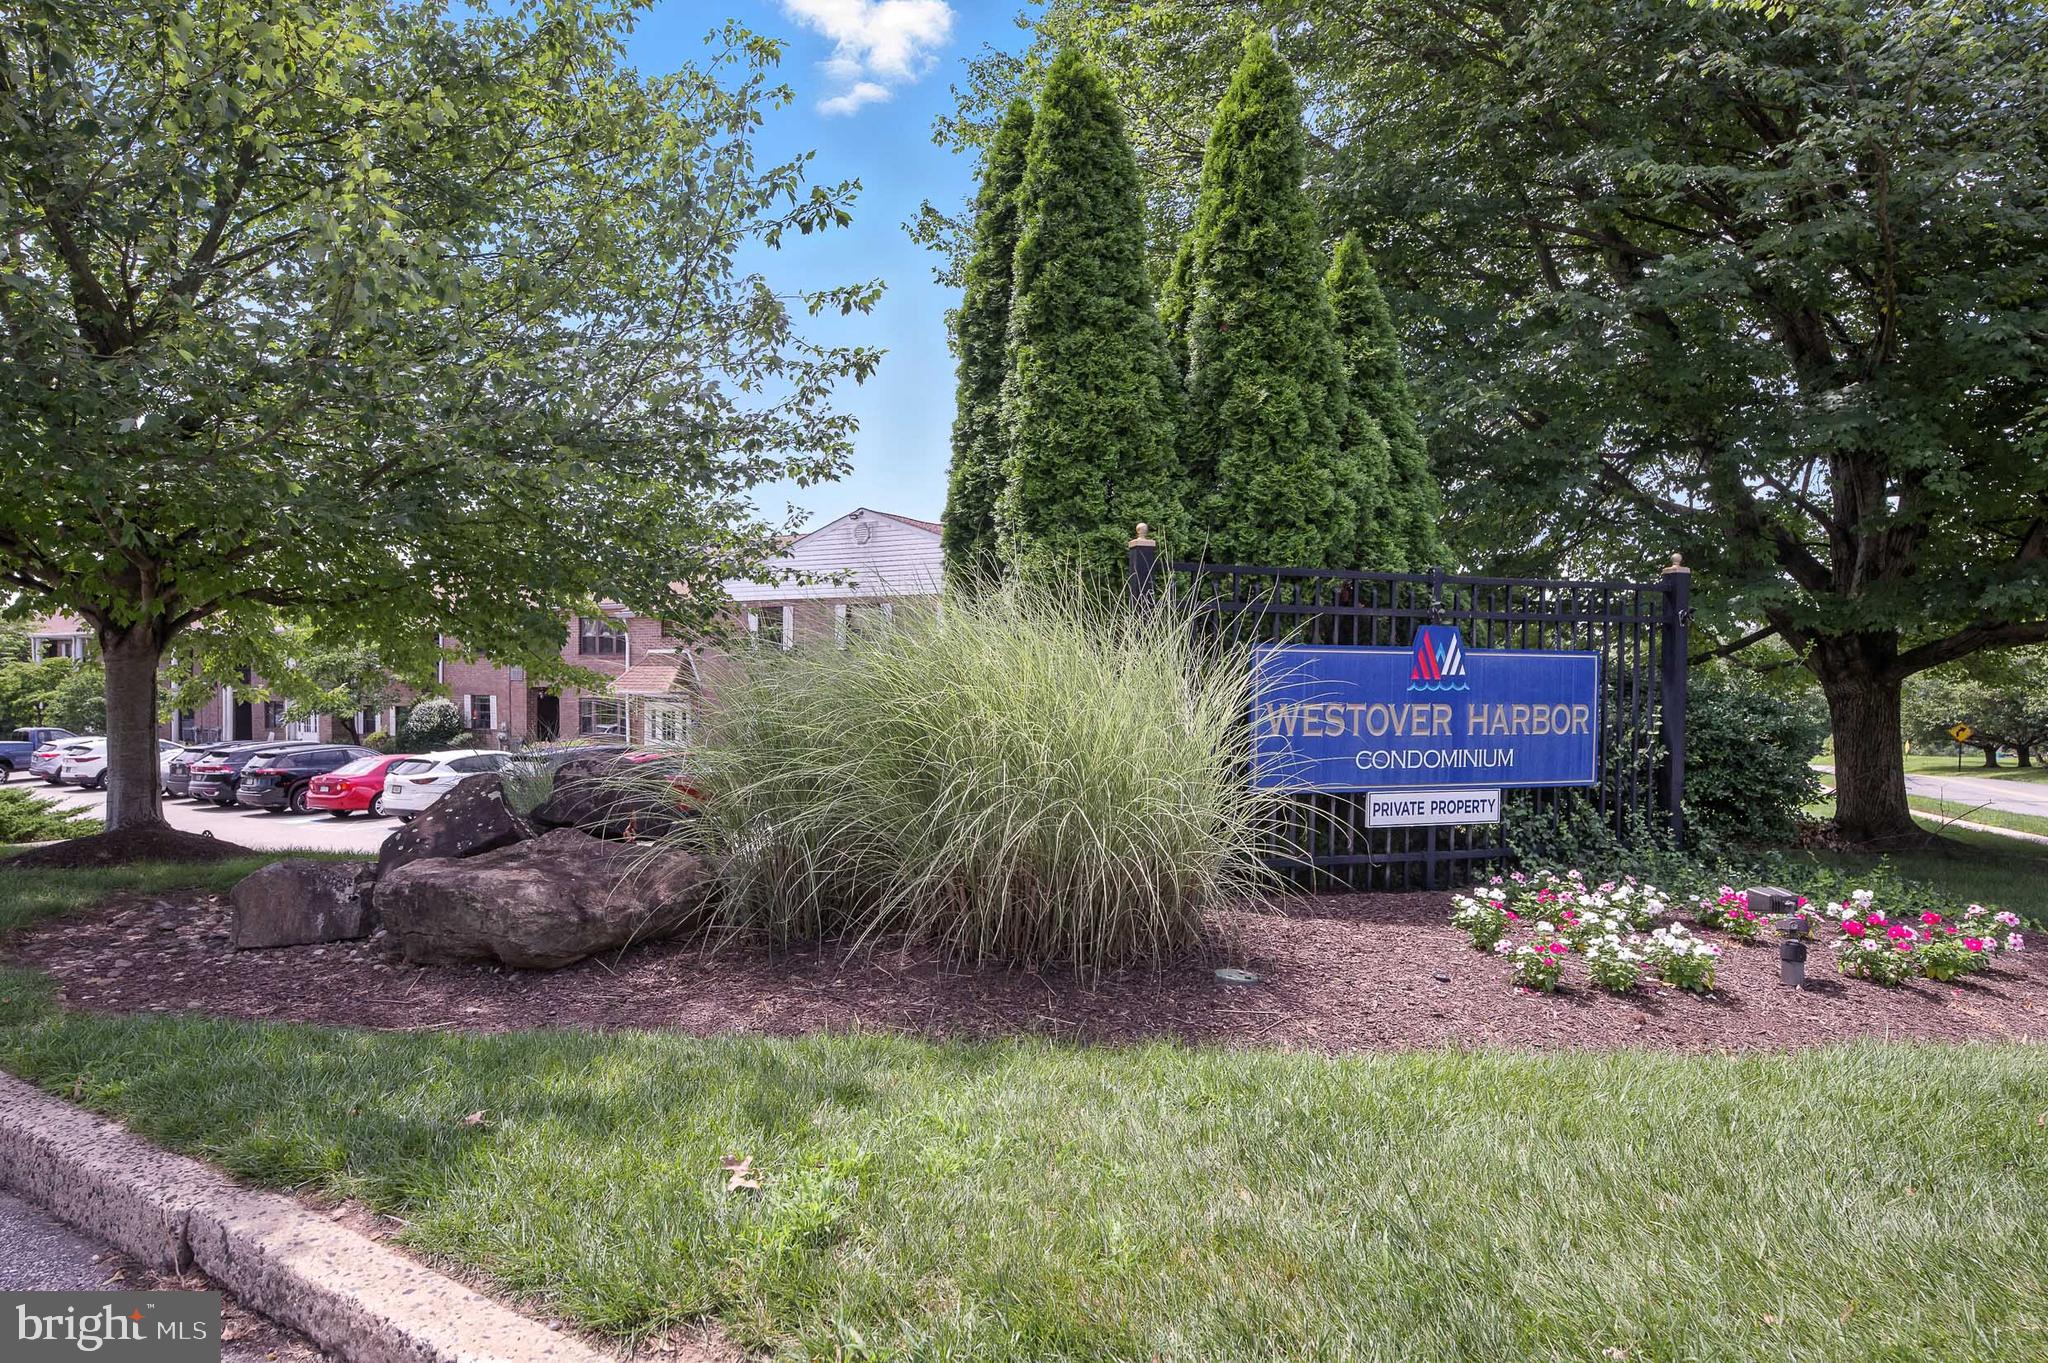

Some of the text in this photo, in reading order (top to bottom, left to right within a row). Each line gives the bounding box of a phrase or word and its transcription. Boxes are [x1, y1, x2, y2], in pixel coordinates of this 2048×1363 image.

[1266, 703, 1590, 737] WESTOVER HARBOR
[1355, 748, 1514, 770] CONDOMINIUM
[1373, 798, 1496, 817] PRIVATE PROPERTY
